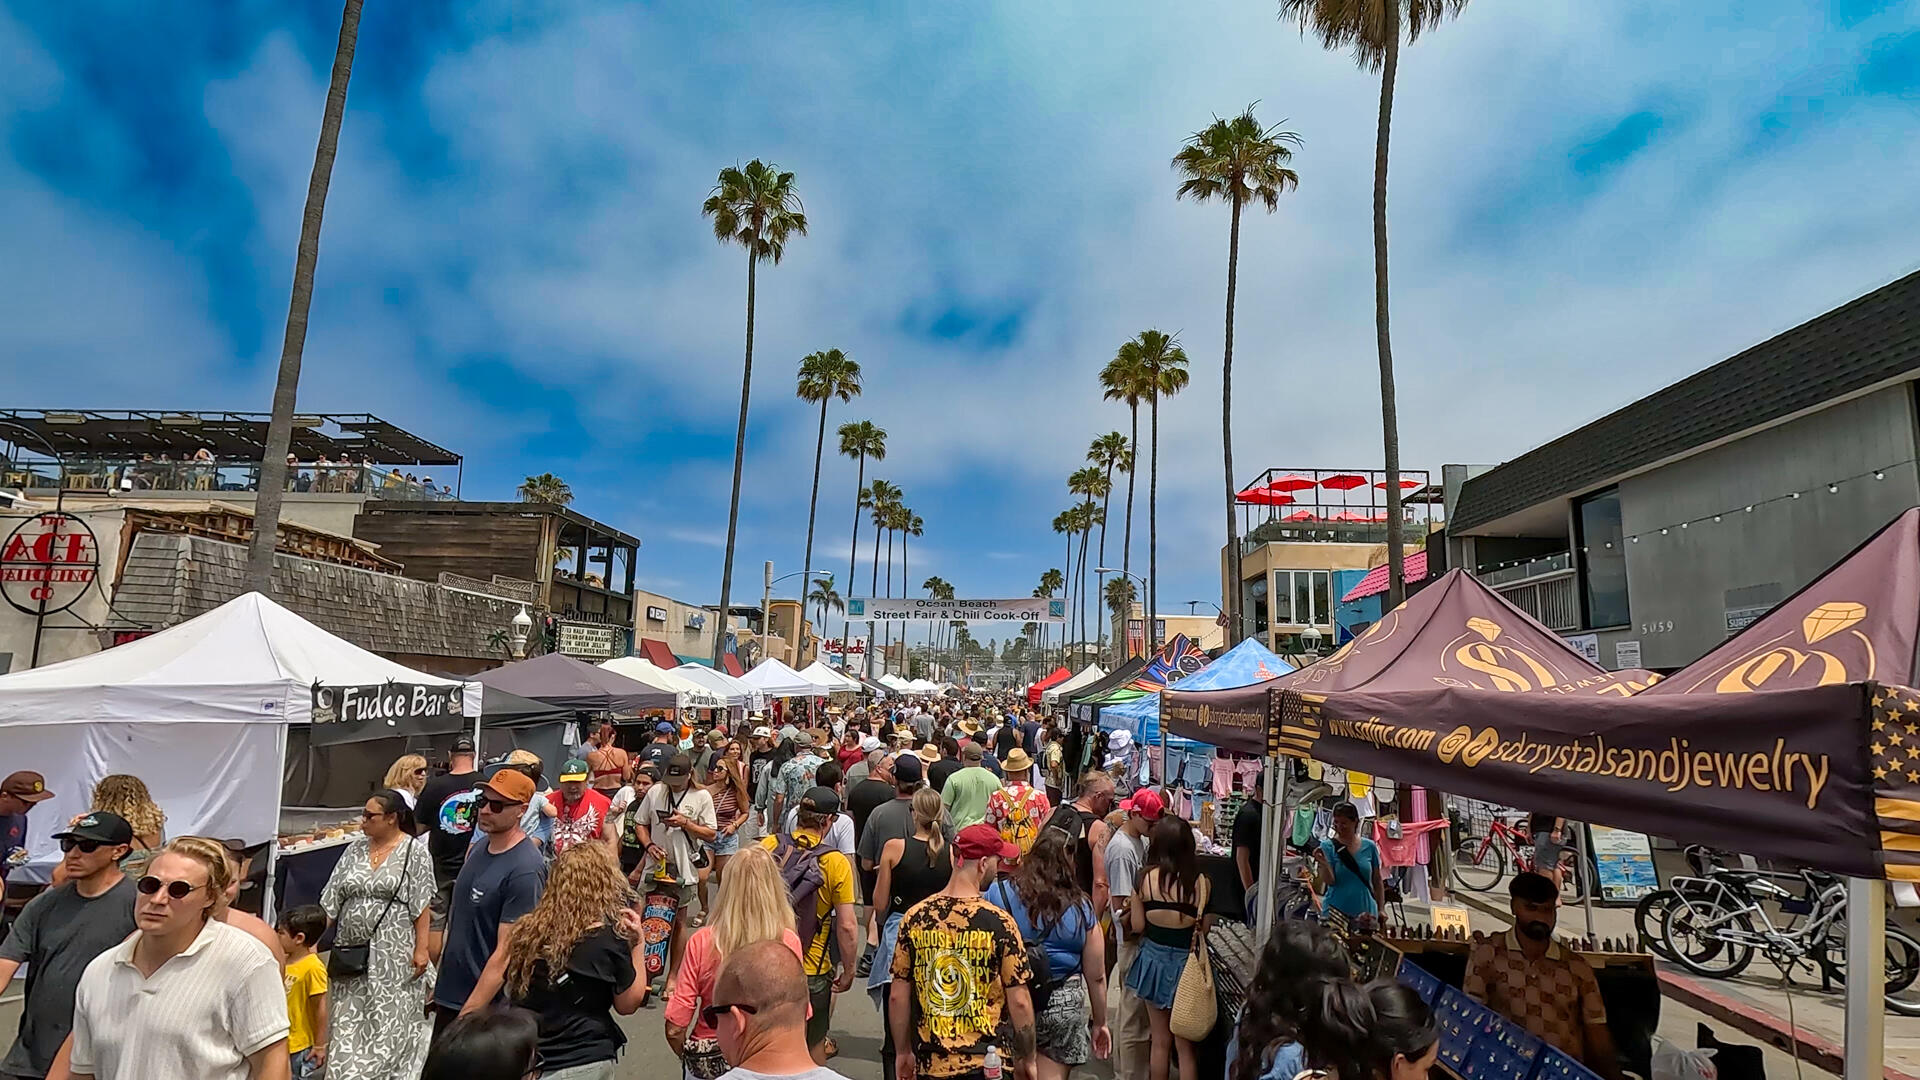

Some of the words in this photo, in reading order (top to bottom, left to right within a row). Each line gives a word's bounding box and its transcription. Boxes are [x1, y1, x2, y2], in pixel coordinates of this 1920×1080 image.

[4, 532, 94, 562] ACE
[31, 587, 54, 600] CO
[916, 600, 955, 608] Ocean
[959, 600, 997, 608] Beach
[873, 610, 910, 619] Street
[914, 610, 937, 619] Fair
[940, 611, 949, 619] &
[953, 610, 980, 620] Chili
[983, 610, 1040, 620] Cook-Off
[1641, 621, 1674, 635] 5059
[341, 685, 405, 726] Fudge
[410, 685, 446, 717] Bar
[1490, 732, 1829, 810] sdcrystalsandjewelry
[1440, 913, 1462, 921] TURTLE
[910, 929, 953, 949] CHOOSE
[955, 930, 994, 949] HAPPY
